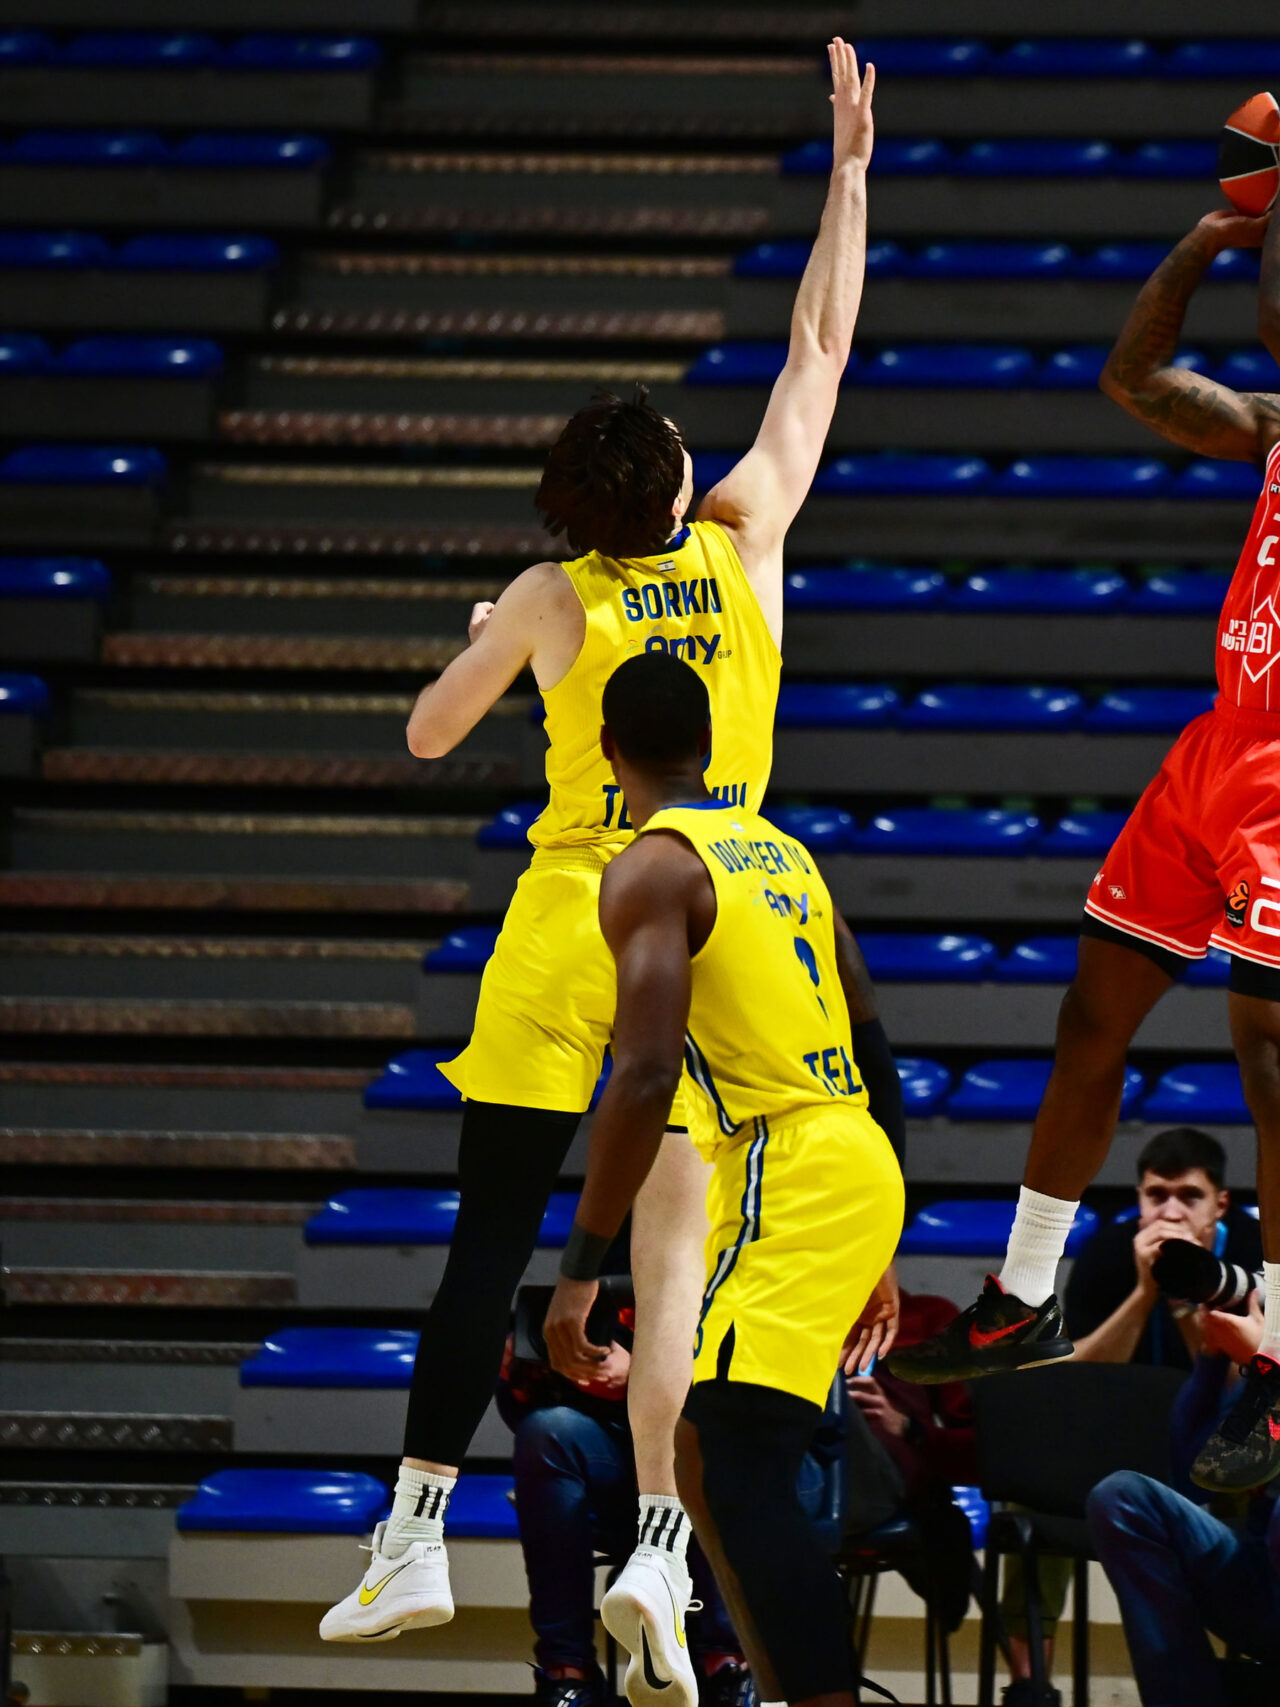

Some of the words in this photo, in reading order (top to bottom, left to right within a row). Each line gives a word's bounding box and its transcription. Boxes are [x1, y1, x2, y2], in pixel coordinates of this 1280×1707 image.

[622, 578, 722, 622] SORKIN
[707, 838, 792, 875] WAER
[802, 1045, 863, 1096] TEL
